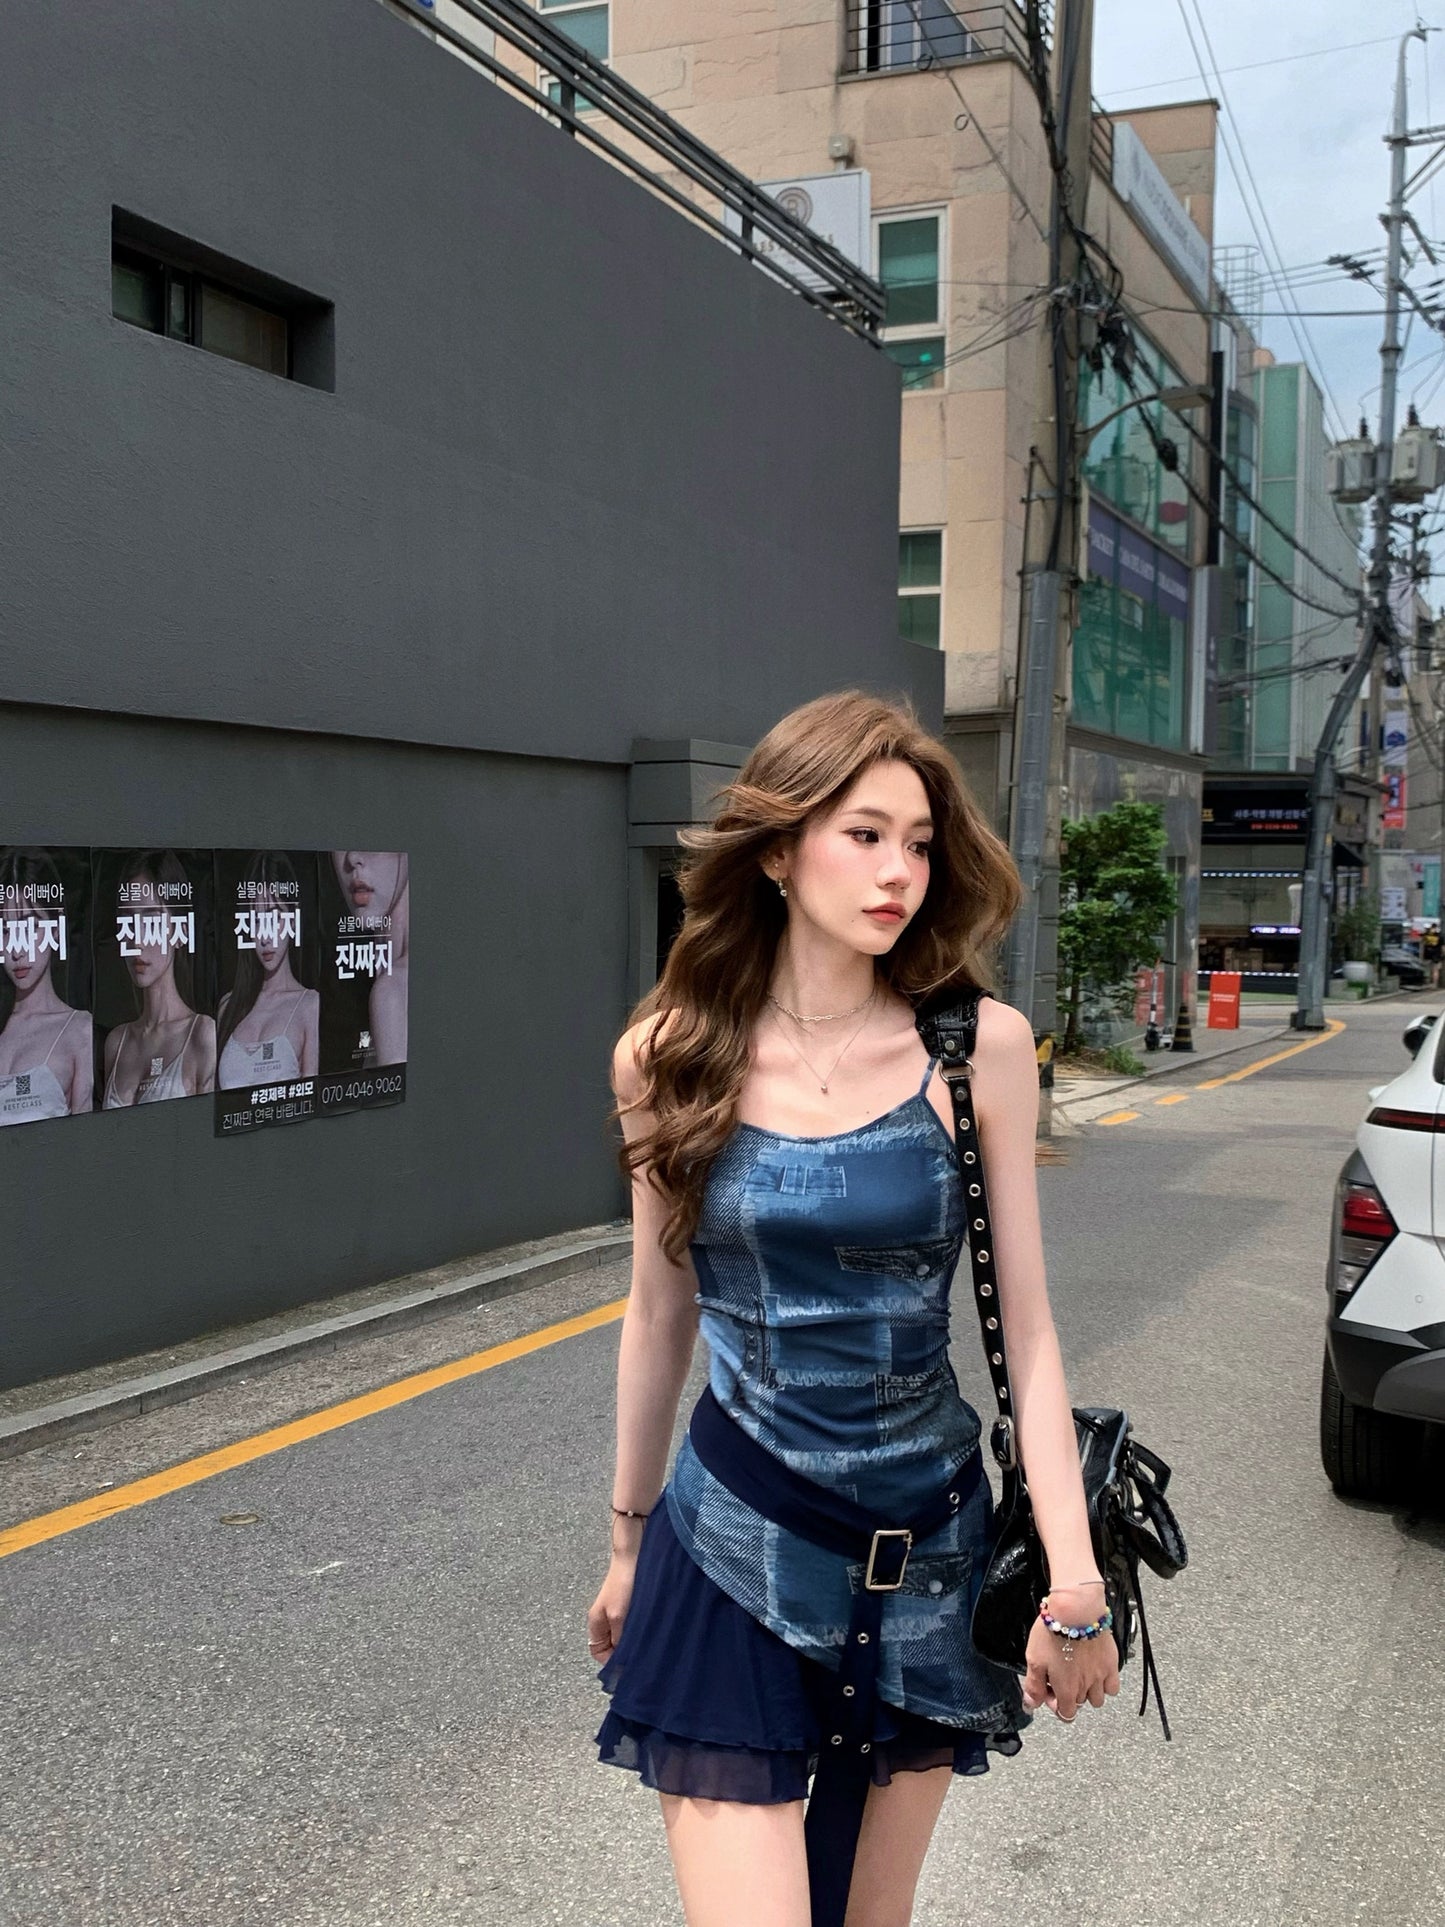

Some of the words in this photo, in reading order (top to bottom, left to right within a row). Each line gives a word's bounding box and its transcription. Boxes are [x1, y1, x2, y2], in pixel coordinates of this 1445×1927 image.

[23, 882, 65, 903] 예뻐야
[118, 882, 154, 902] 실물이
[157, 882, 193, 900] 예뻐야
[236, 881, 267, 898] 실물이
[269, 881, 300, 898] 예뻐야
[115, 911, 195, 957] 진짜지
[233, 908, 301, 950] 진짜지
[337, 916, 364, 933] 실물이
[366, 915, 392, 932] 예뻐야
[335, 940, 393, 980] 진짜지
[250, 1086, 287, 1105] #경제력
[288, 1081, 314, 1097] #외모
[321, 1085, 343, 1104] 070
[345, 1081, 373, 1099] 4046
[375, 1075, 402, 1093] 9062
[3, 1102, 20, 1112] BEST
[21, 1099, 43, 1109] CLASS
[222, 1112, 253, 1130] 진짜만
[254, 1107, 274, 1124] 연락
[276, 1100, 315, 1119] 바랍니다.
